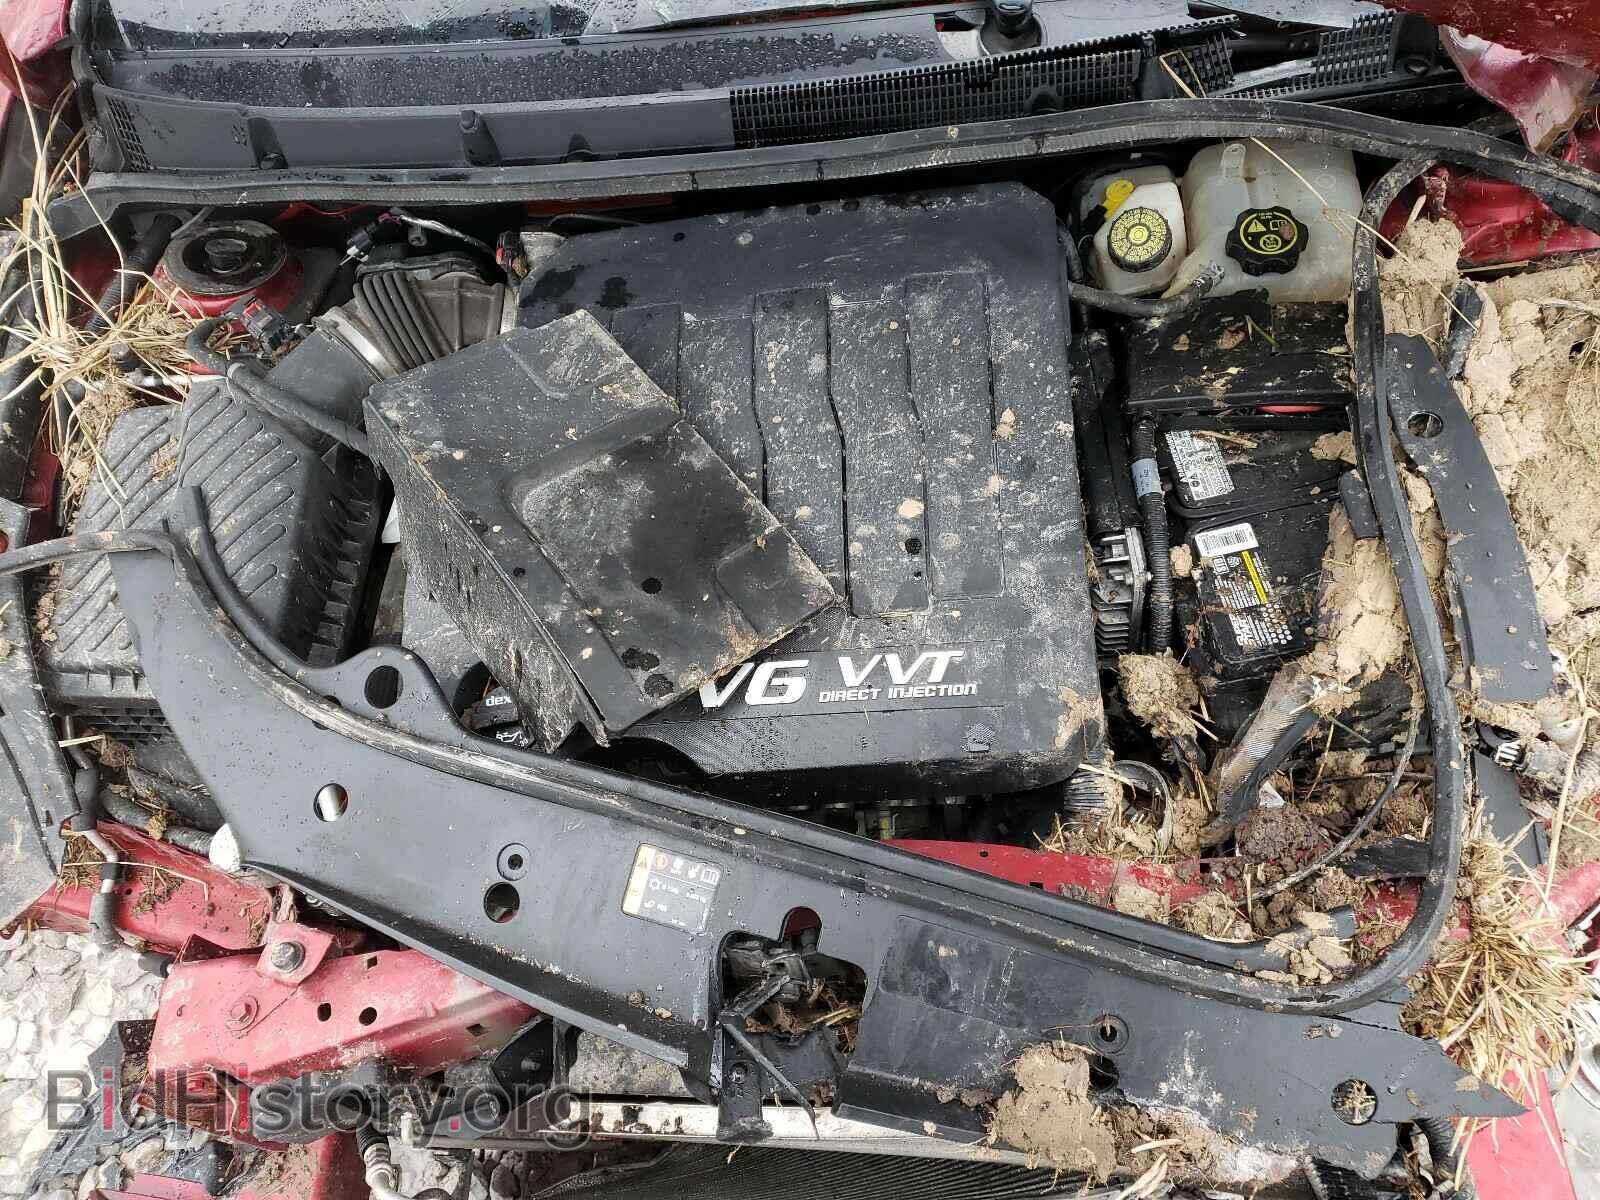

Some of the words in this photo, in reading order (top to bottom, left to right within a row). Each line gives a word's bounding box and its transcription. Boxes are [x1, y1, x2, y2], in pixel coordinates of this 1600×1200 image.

[698, 660, 809, 709] V6
[838, 650, 964, 687] VVT
[818, 688, 881, 704] DIRECT
[888, 684, 978, 699] INJECTION
